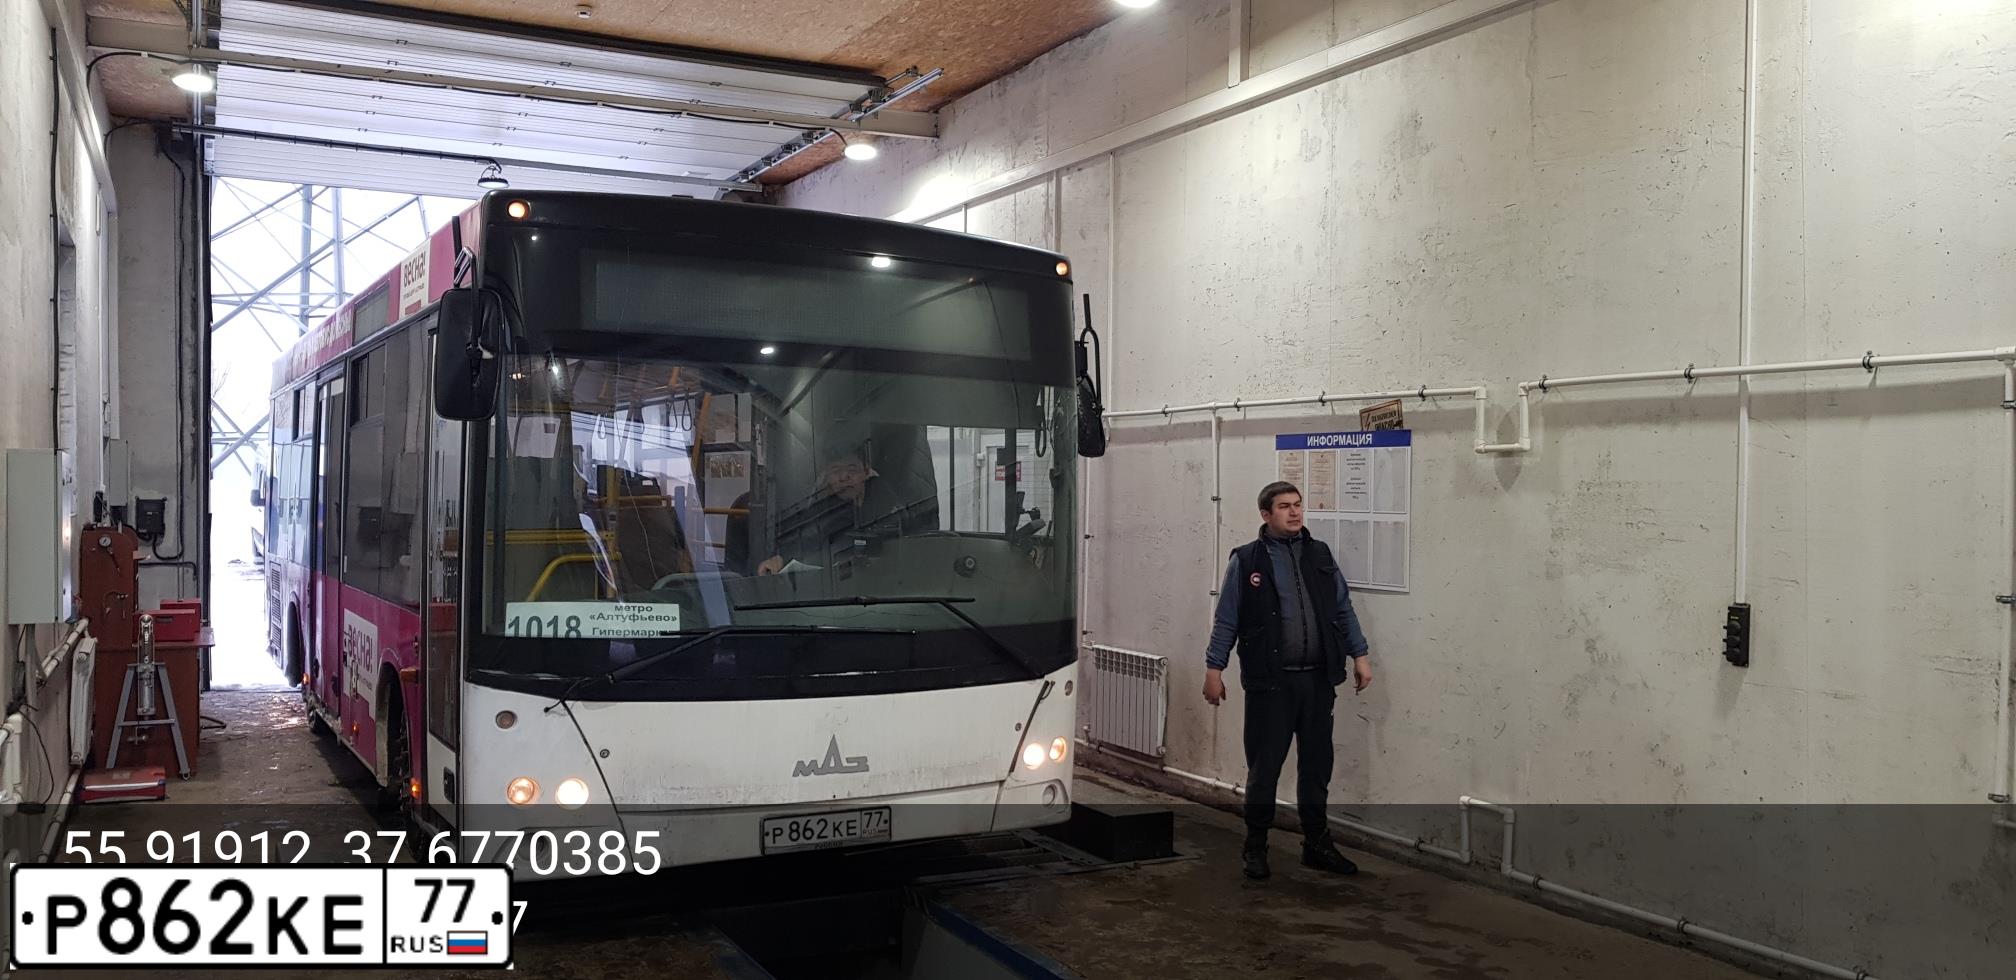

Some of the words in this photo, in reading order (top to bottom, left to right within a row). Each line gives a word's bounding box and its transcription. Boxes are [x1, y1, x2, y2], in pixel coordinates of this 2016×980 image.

[1307, 434, 1373, 447] ИНФОРМАЦИЯ
[614, 605, 653, 614] метро
[589, 612, 677, 623] «Алтуфьево»
[508, 614, 582, 639] 1018
[863, 811, 884, 828] 77
